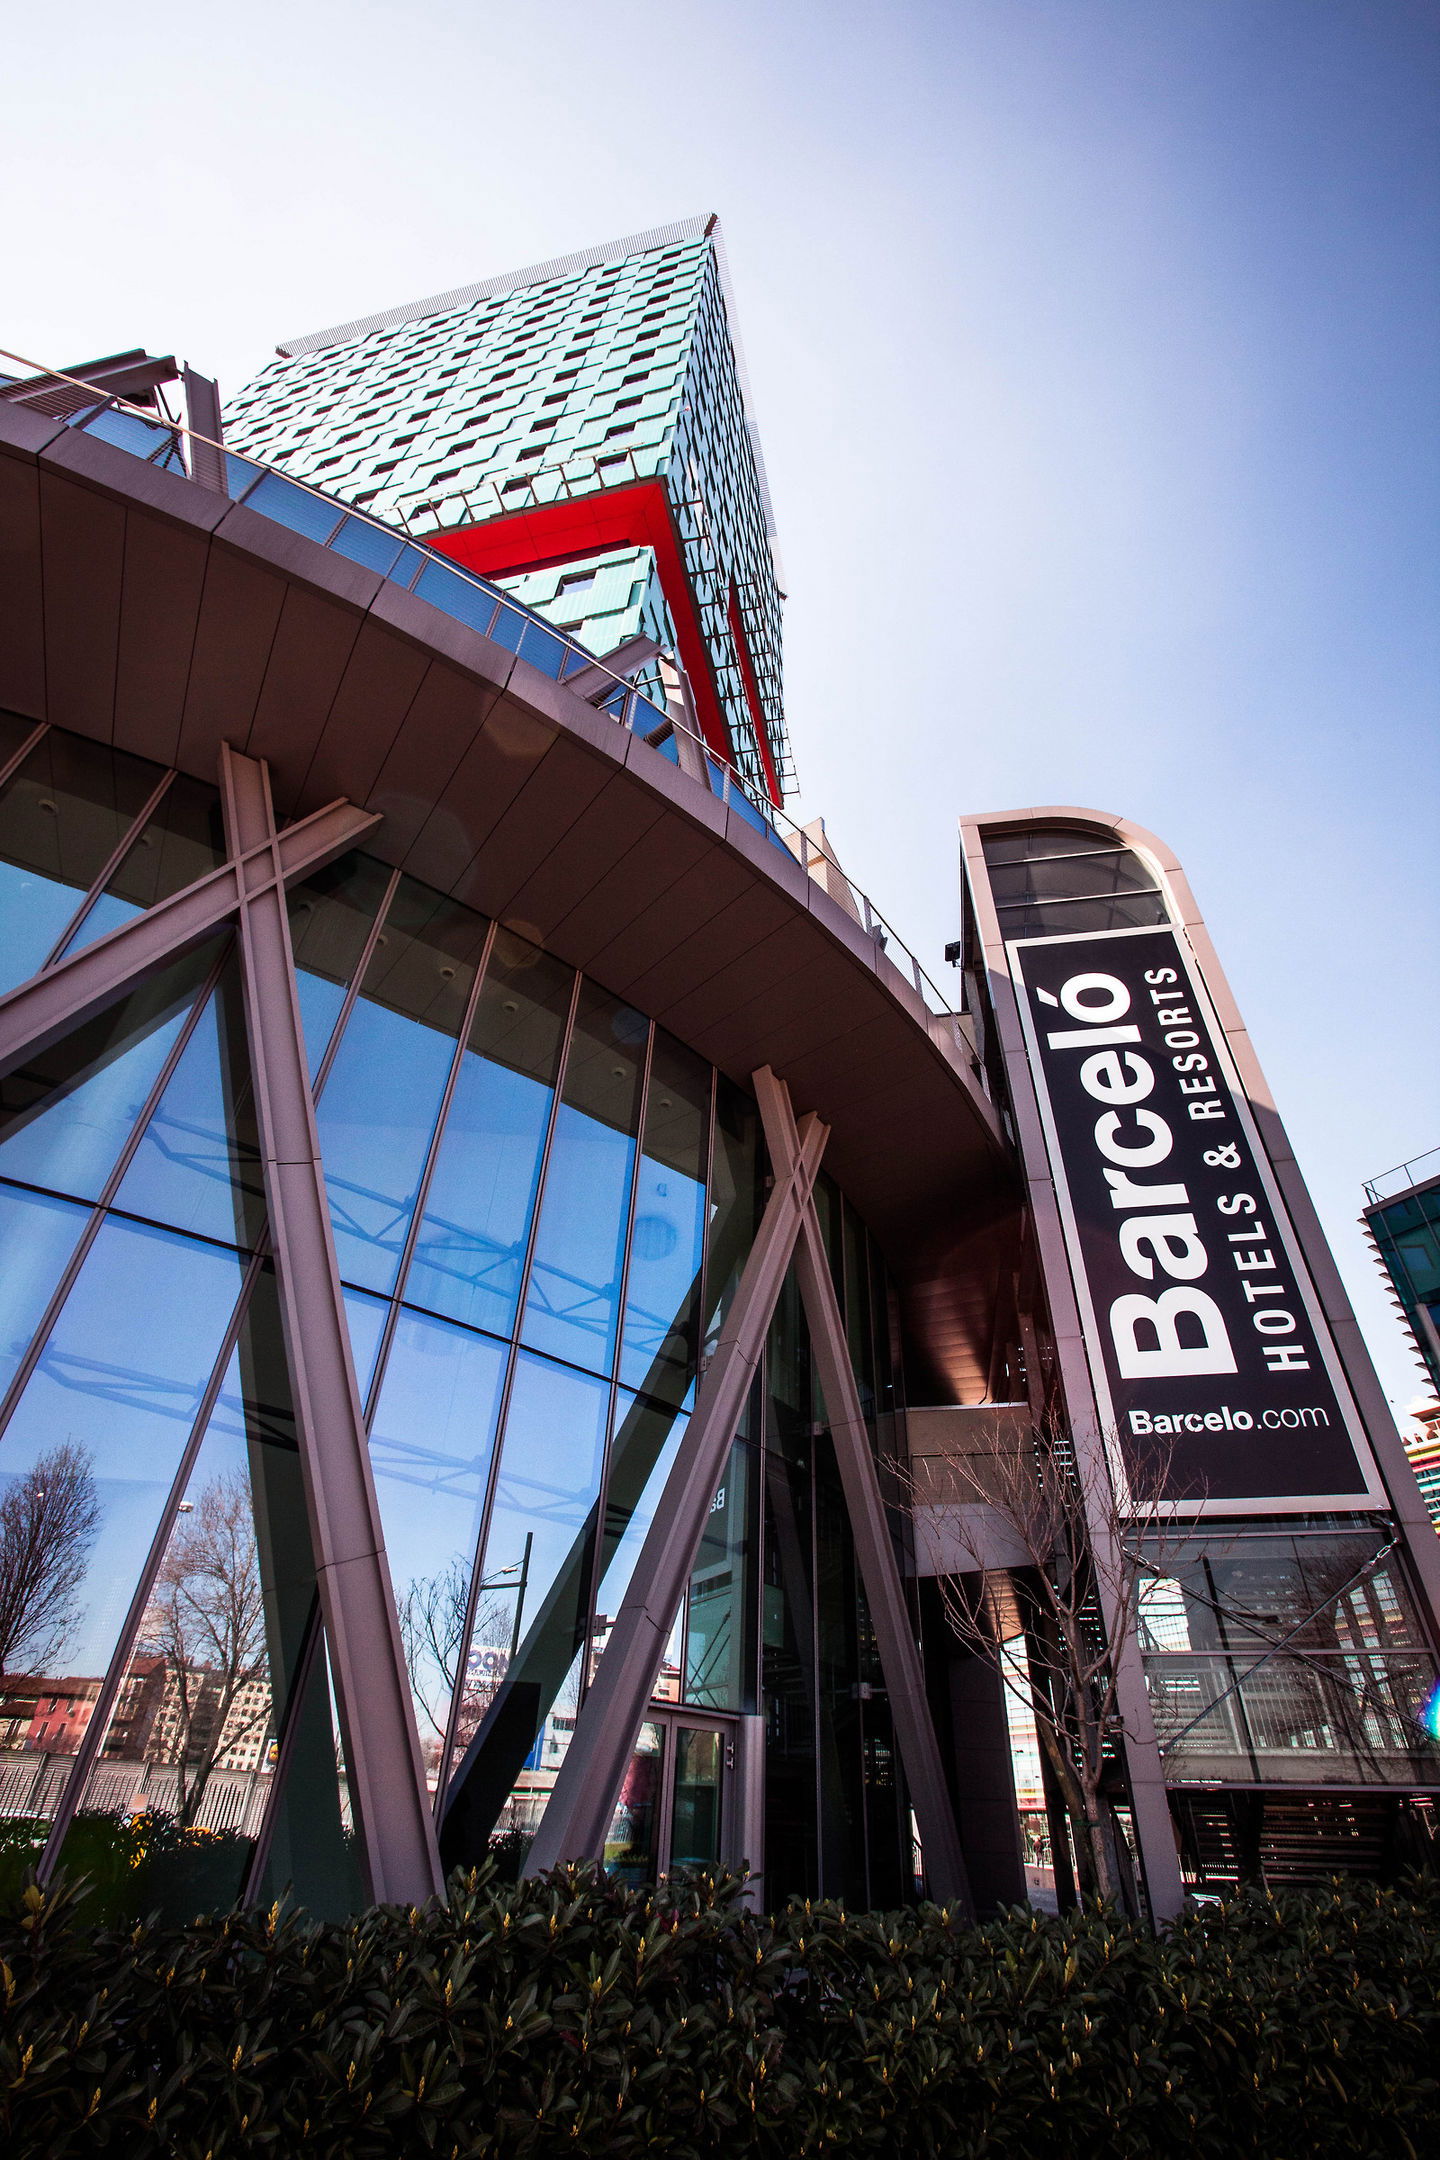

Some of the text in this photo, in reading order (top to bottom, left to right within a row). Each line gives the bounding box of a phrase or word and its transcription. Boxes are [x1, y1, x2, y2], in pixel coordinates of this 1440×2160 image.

[1035, 972, 1239, 1380] Barceló
[1144, 967, 1311, 1372] HOTELS & RESORTS
[1128, 1405, 1331, 1435] Barcelo.com
